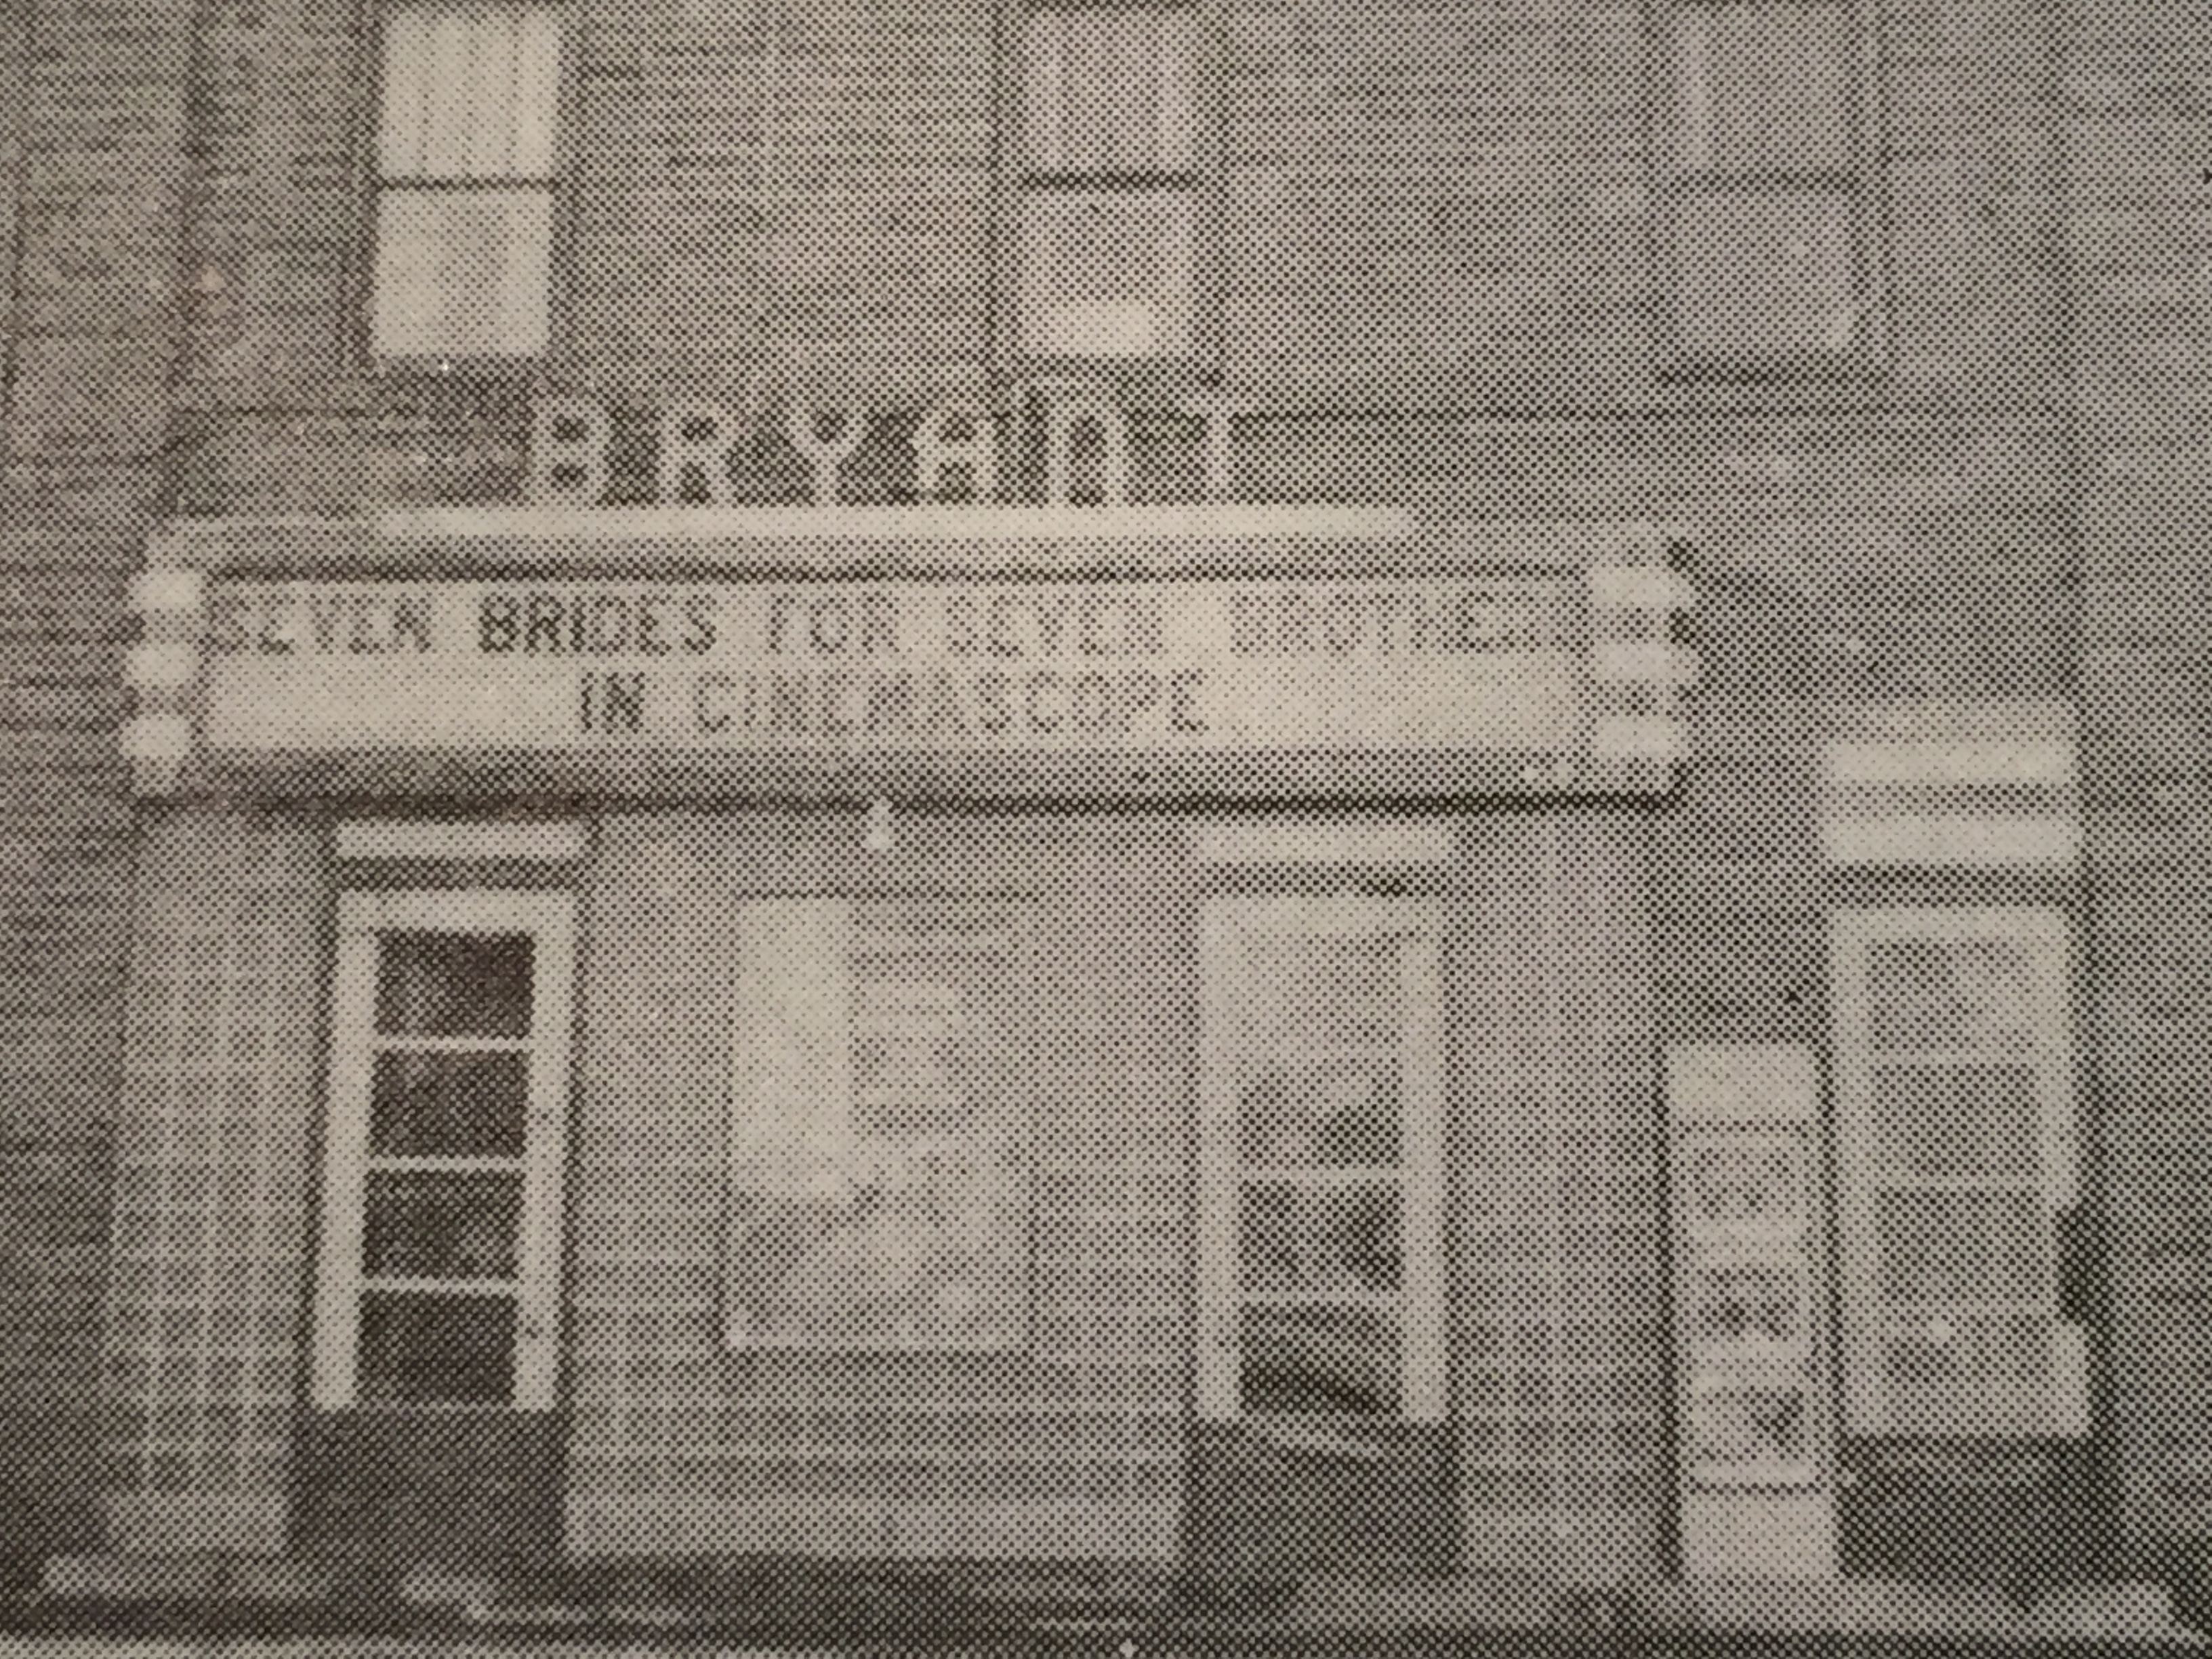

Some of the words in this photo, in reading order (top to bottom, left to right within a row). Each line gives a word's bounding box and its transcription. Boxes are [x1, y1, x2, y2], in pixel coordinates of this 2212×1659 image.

[526, 393, 1255, 503] BRYANT
[205, 592, 432, 655] SEVEN
[478, 591, 718, 655] BRIDES
[765, 592, 900, 656] FOR
[947, 591, 1166, 657] SEVEN
[578, 671, 644, 735] IN
[693, 670, 1210, 736] CINEMASCOPE
